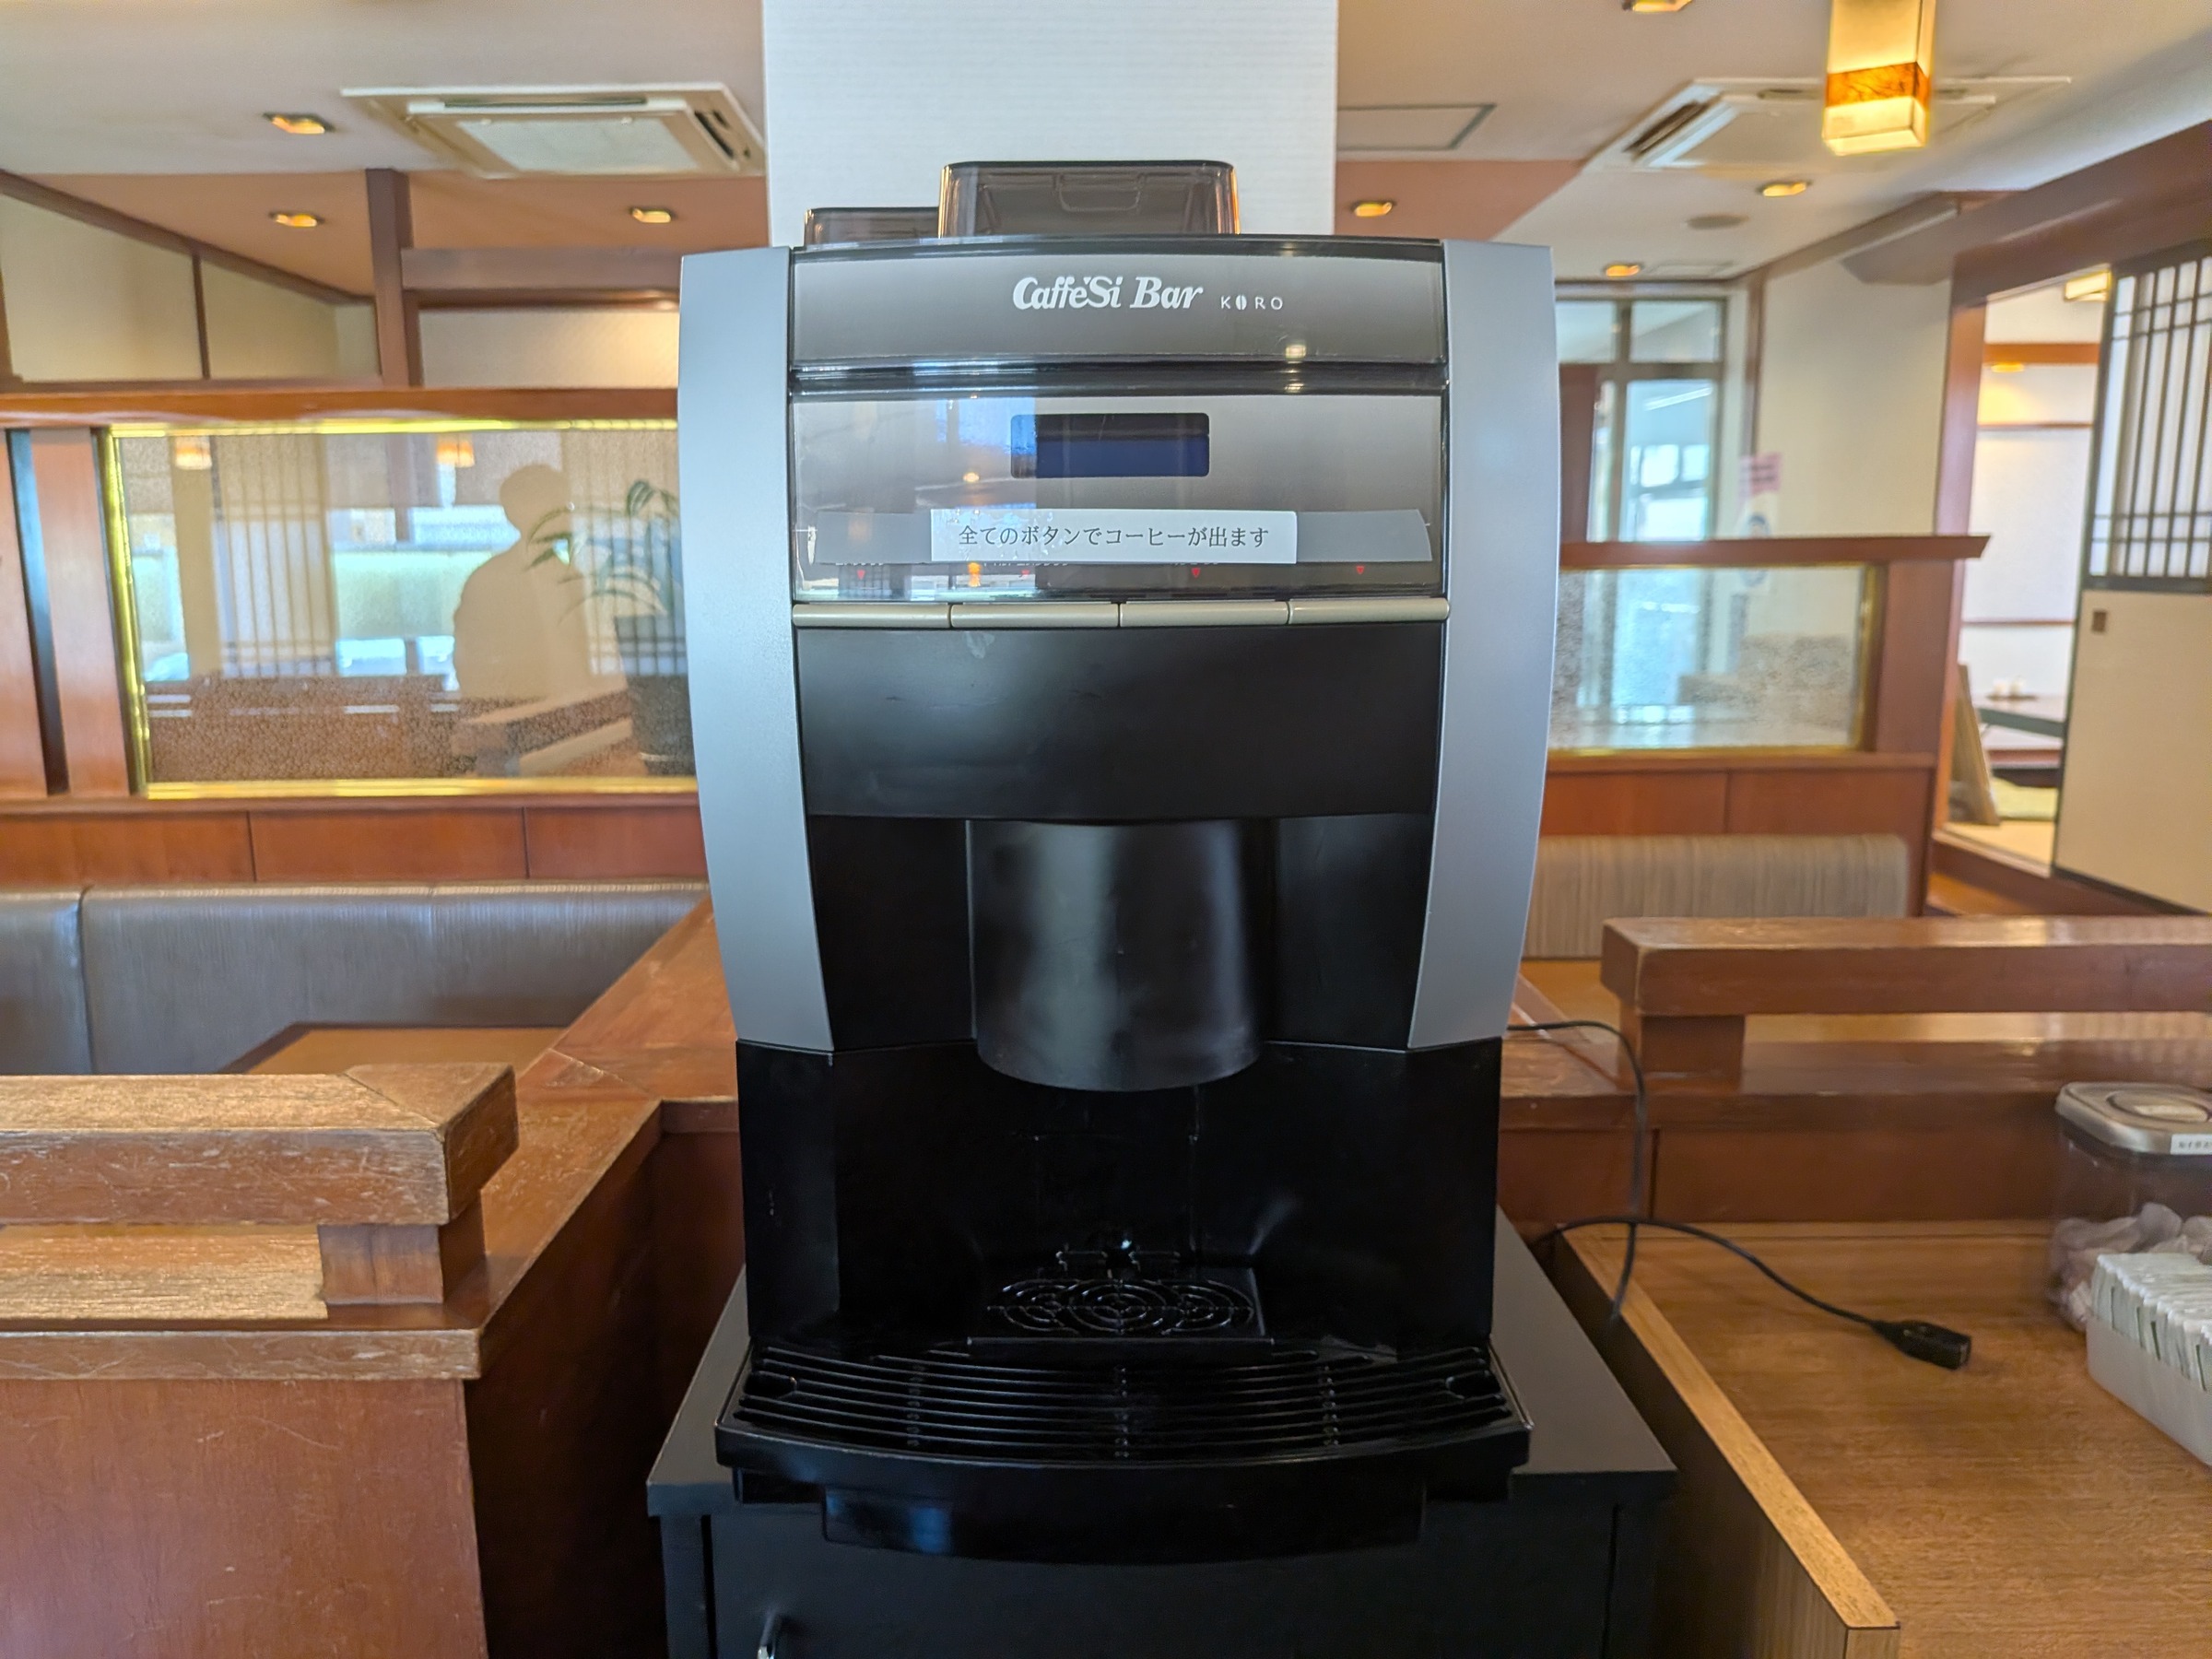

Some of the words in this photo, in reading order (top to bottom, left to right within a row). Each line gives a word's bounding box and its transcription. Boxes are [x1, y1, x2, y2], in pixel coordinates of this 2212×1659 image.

[1130, 276, 1204, 309] Bar
[1220, 295, 1283, 311] KORO
[959, 524, 1269, 548] 全てのボタンでコーヒーが出ます
